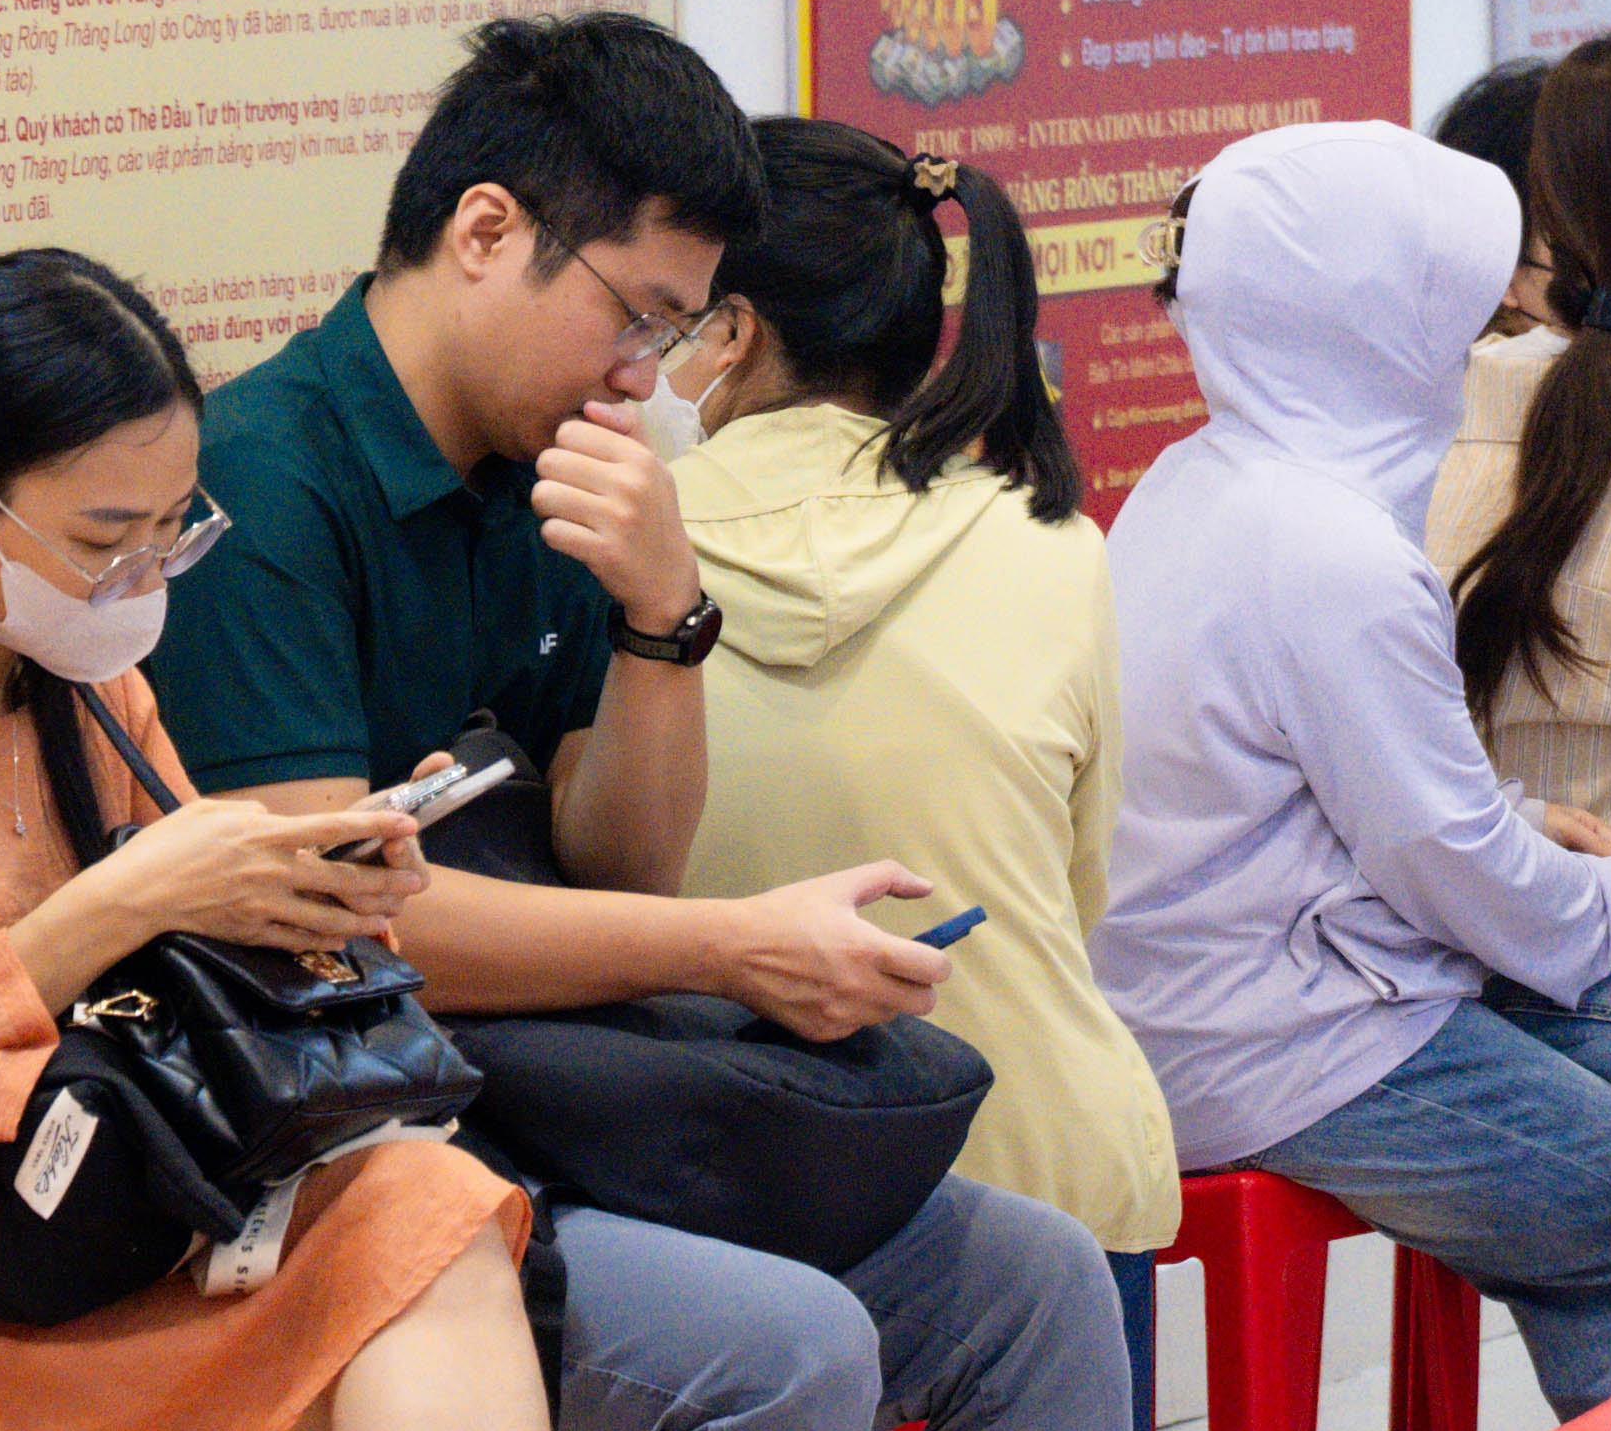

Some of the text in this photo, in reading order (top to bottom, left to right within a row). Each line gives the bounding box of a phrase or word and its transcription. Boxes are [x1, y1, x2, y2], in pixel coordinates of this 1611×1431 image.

[1030, 112, 1164, 148] INTERNATIONAL
[1169, 108, 1207, 138] STAR
[1212, 103, 1247, 134] FOR
